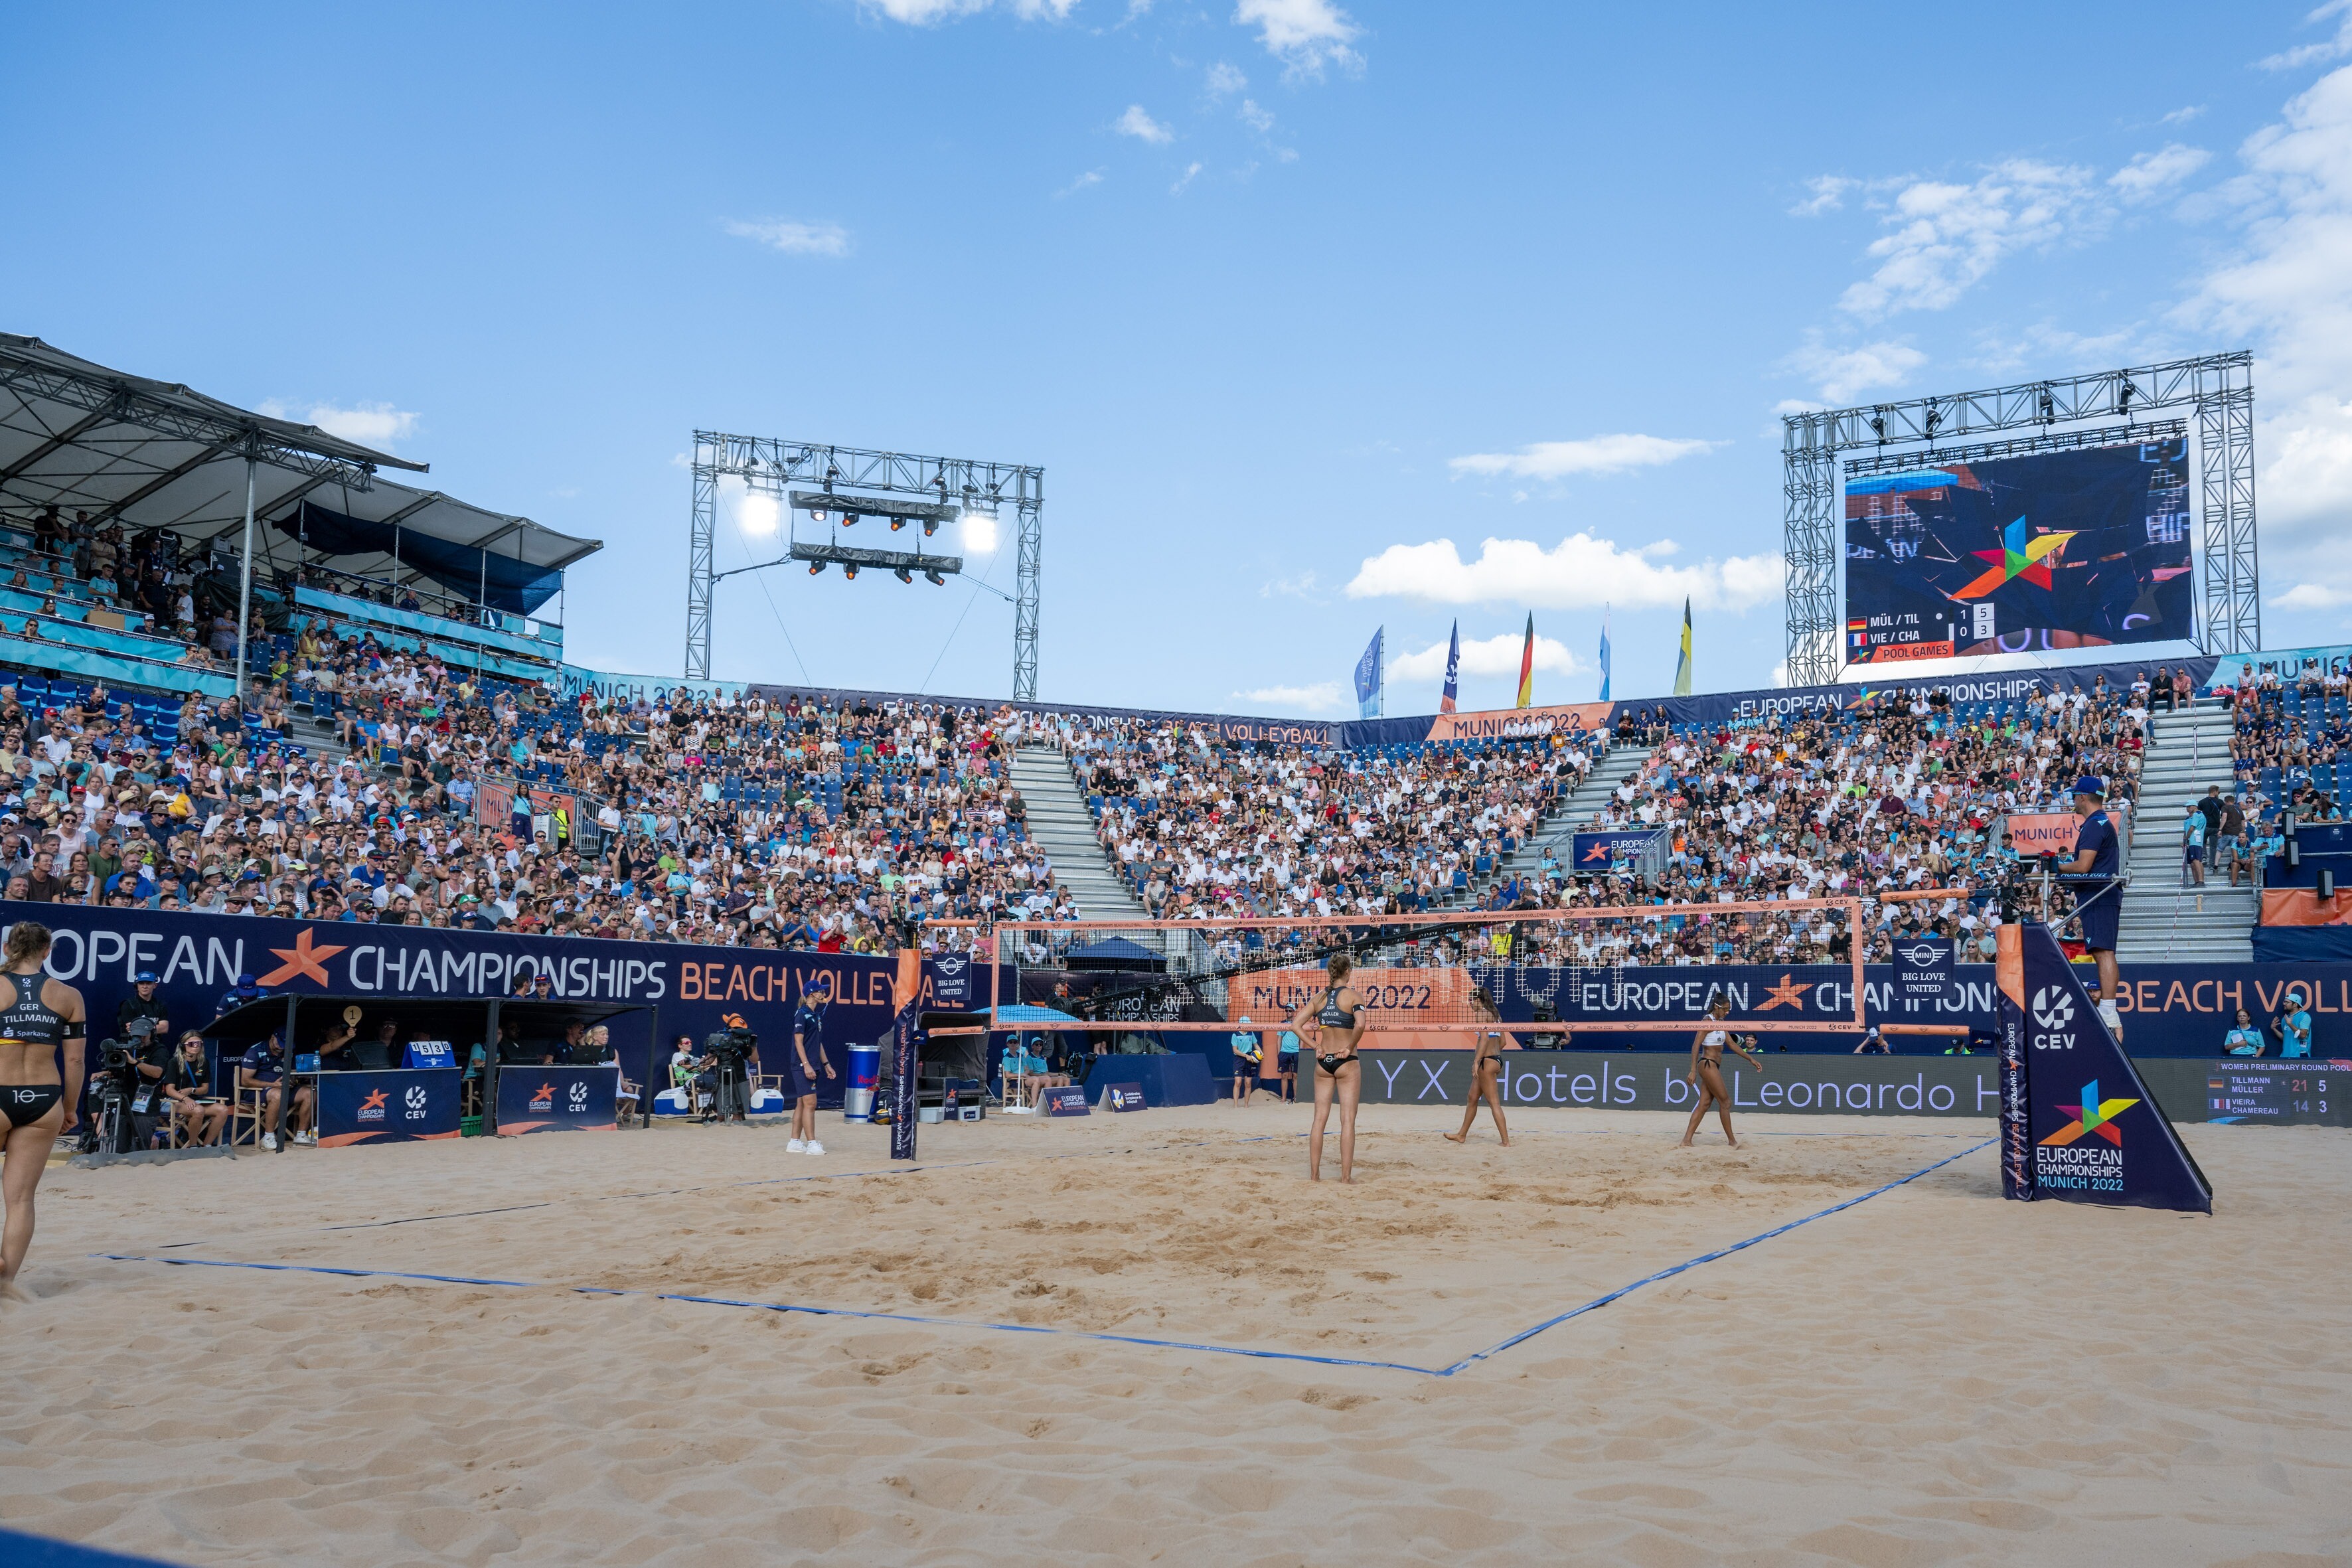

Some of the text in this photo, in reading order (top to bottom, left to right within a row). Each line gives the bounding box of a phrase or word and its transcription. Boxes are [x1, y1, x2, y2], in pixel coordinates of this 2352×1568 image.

[1870, 613, 1893, 627] MÜL
[1904, 613, 1920, 625] TIL
[1960, 609, 1966, 619] 1
[1980, 607, 1987, 618] 5
[0, 633, 25, 641] EUROPEAN
[32, 638, 66, 649] CHAMPIONSHIPS
[1870, 633, 1887, 644] VIE
[1898, 630, 1920, 642] CHA
[1960, 627, 1967, 637] 0
[1980, 625, 1987, 635] 3
[1883, 645, 1948, 659] POOL GAMES
[564, 673, 644, 702] MUNICH
[2015, 827, 2073, 841] MUNICH
[349, 945, 666, 998] CHAMPIONSHIPS
[680, 962, 787, 1002] BEACH
[1920, 972, 1946, 980] LOVE
[25, 991, 31, 1000] 1
[1366, 984, 1431, 1010] 2022
[1583, 981, 1749, 1011] EUROPEAN
[2116, 980, 2242, 1012] BEACH
[3, 1014, 58, 1024] TILLMANN
[349, 1009, 356, 1020] 1
[422, 1044, 429, 1053] 5
[434, 1044, 441, 1053] 3
[2007, 1023, 2017, 1059] EUROPEAN
[2034, 1034, 2076, 1050] CEV
[1496, 1060, 1637, 1104] Hotels
[1734, 1070, 1955, 1111] Leonardo
[2231, 1085, 2264, 1093] MÜLLER
[2292, 1079, 2308, 1092] 21
[2318, 1079, 2327, 1093] 5
[2009, 1070, 2019, 1122] CHAMPIONSHIPS
[2293, 1099, 2310, 1113] 14
[2319, 1100, 2327, 1113] 3
[405, 1110, 426, 1119] CEV
[2036, 1147, 2122, 1166] EUROPEAN
[2013, 1146, 2023, 1189] VOLLEYBALL
[2037, 1163, 2123, 1178] CHAMPIONSHIPS
[2038, 1176, 2124, 1191] MUNICH 2022
